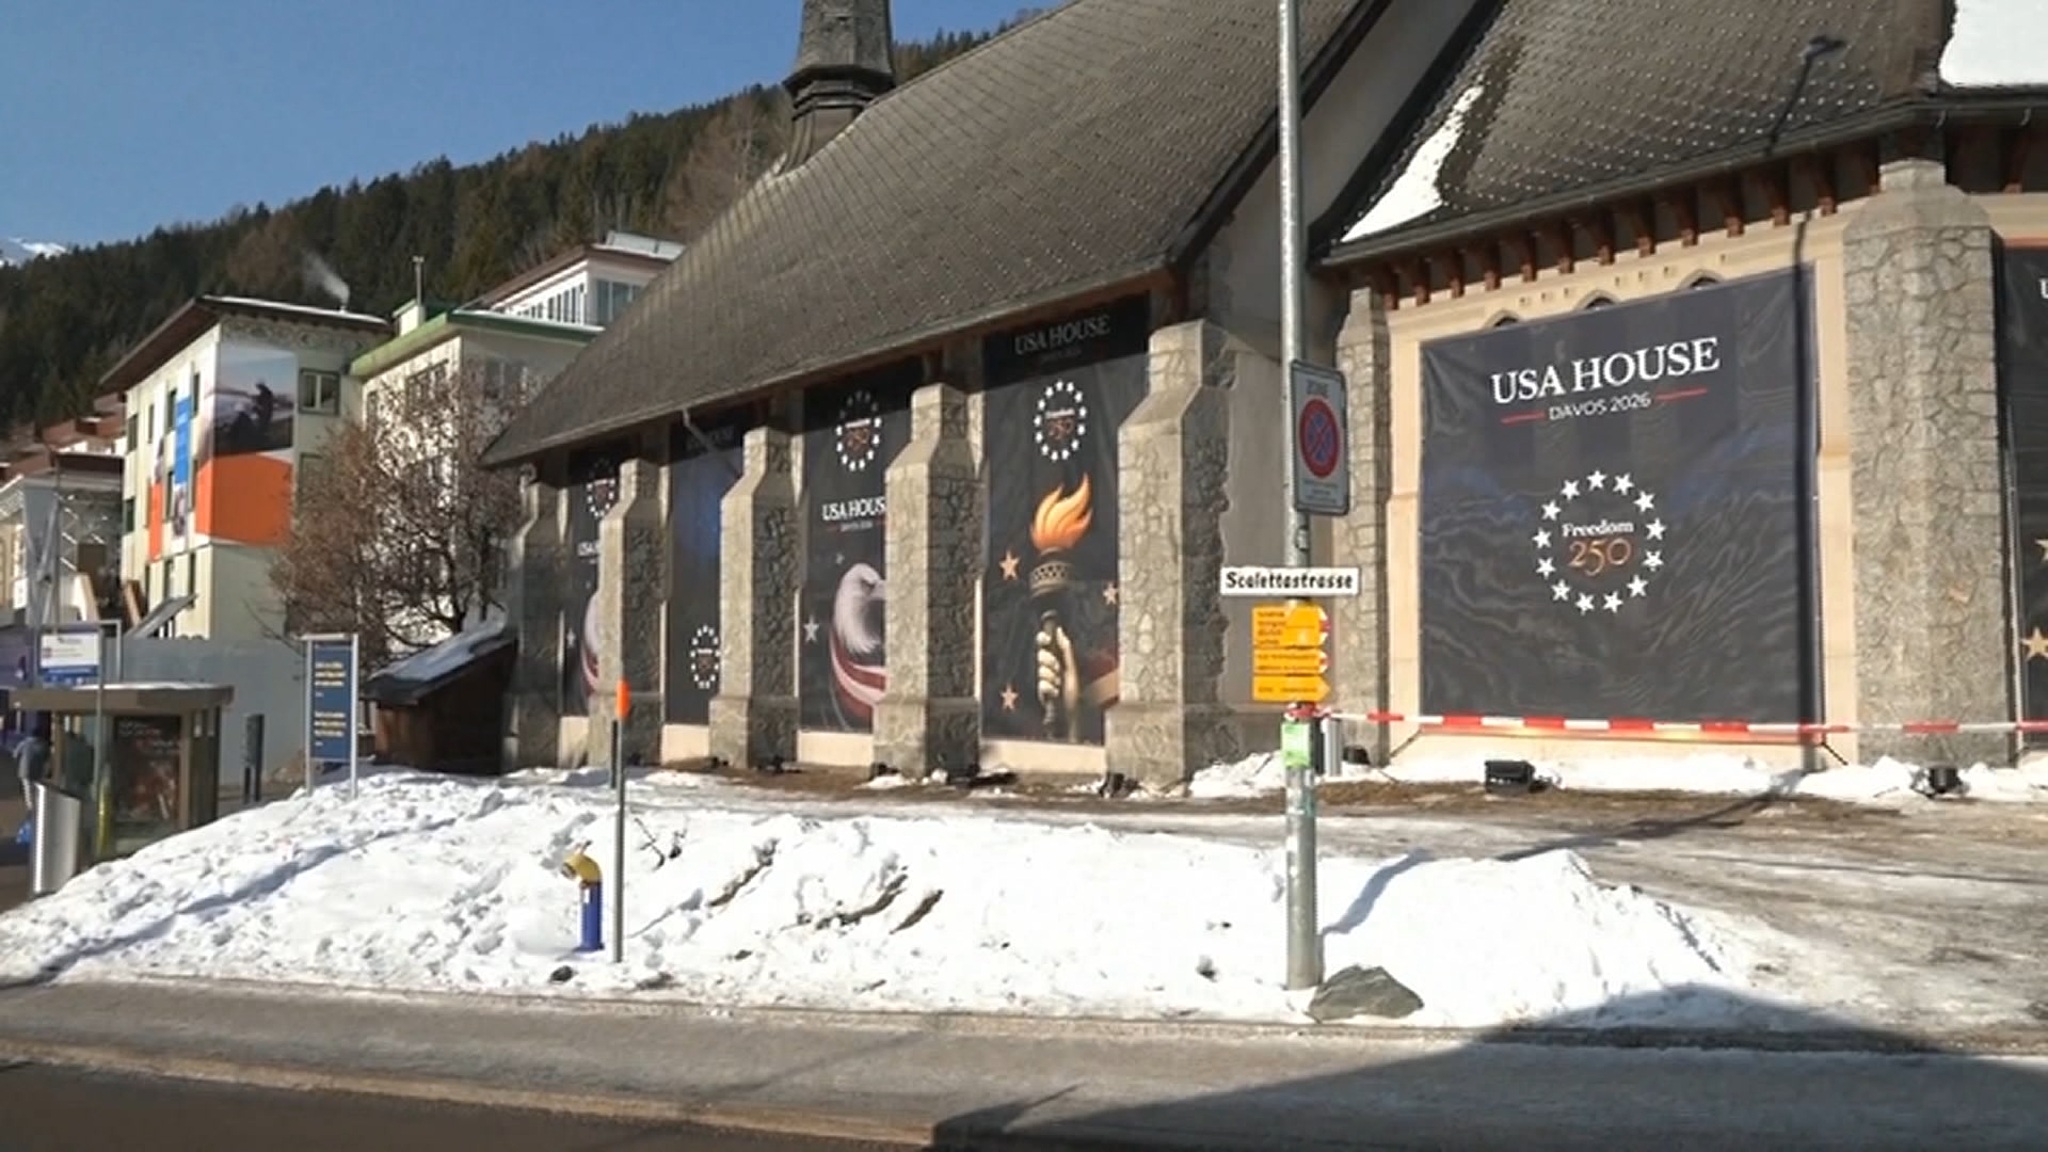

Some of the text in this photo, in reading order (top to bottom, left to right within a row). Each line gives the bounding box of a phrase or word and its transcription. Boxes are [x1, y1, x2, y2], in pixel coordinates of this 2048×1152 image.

[1014, 332, 1047, 355] USA
[1048, 313, 1111, 349] HOUSE
[1491, 336, 1720, 404] USA HOUSE
[1549, 393, 1652, 422] DAVOS 2026
[821, 495, 886, 521] USA HOUS
[1561, 518, 1634, 538] Freedom
[1568, 538, 1633, 577] 250
[1225, 570, 1354, 589] Scalettastrasse
